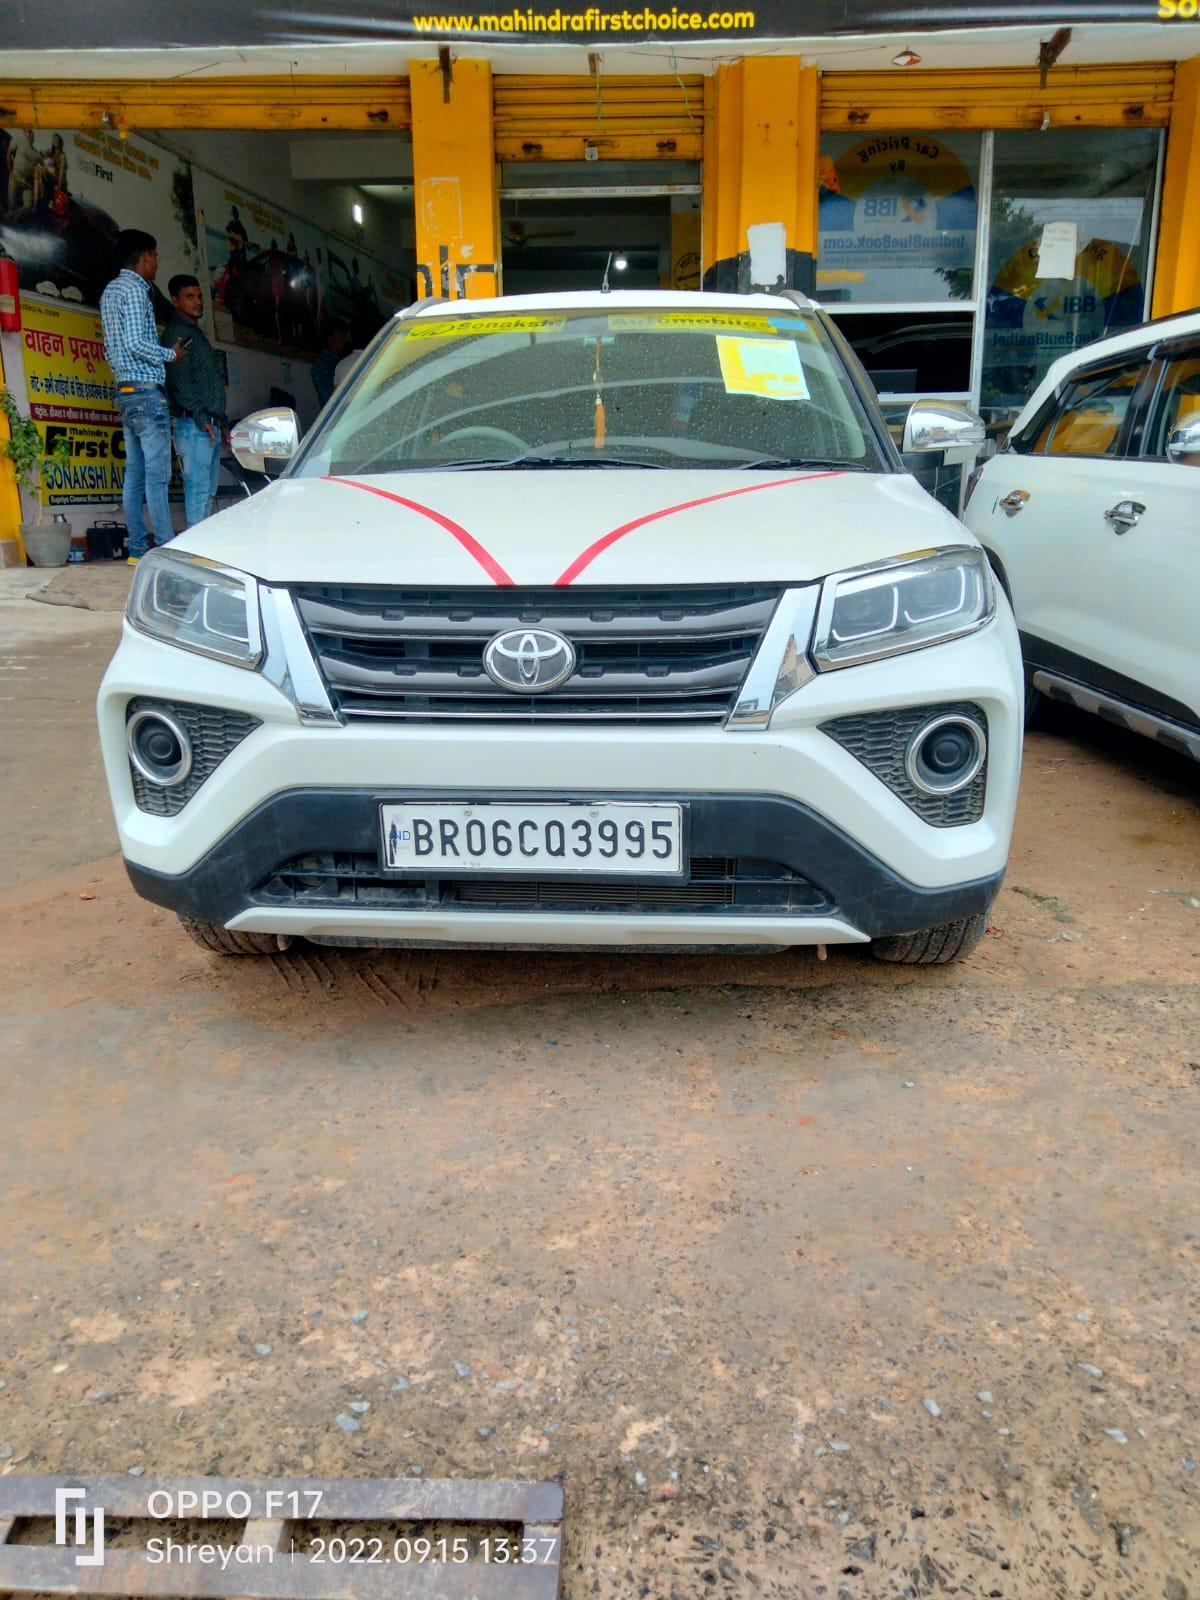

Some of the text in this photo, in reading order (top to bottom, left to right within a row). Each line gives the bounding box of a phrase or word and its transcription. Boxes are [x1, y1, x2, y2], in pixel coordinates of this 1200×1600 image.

[1158, 0, 1200, 18] So
[413, 8, 755, 32] www.mahindrafirstchoice.com
[1063, 296, 1096, 314] IBB
[23, 328, 65, 357] वाहन
[69, 427, 109, 438] Mahindra
[412, 818, 673, 859] BR06CQ3995
